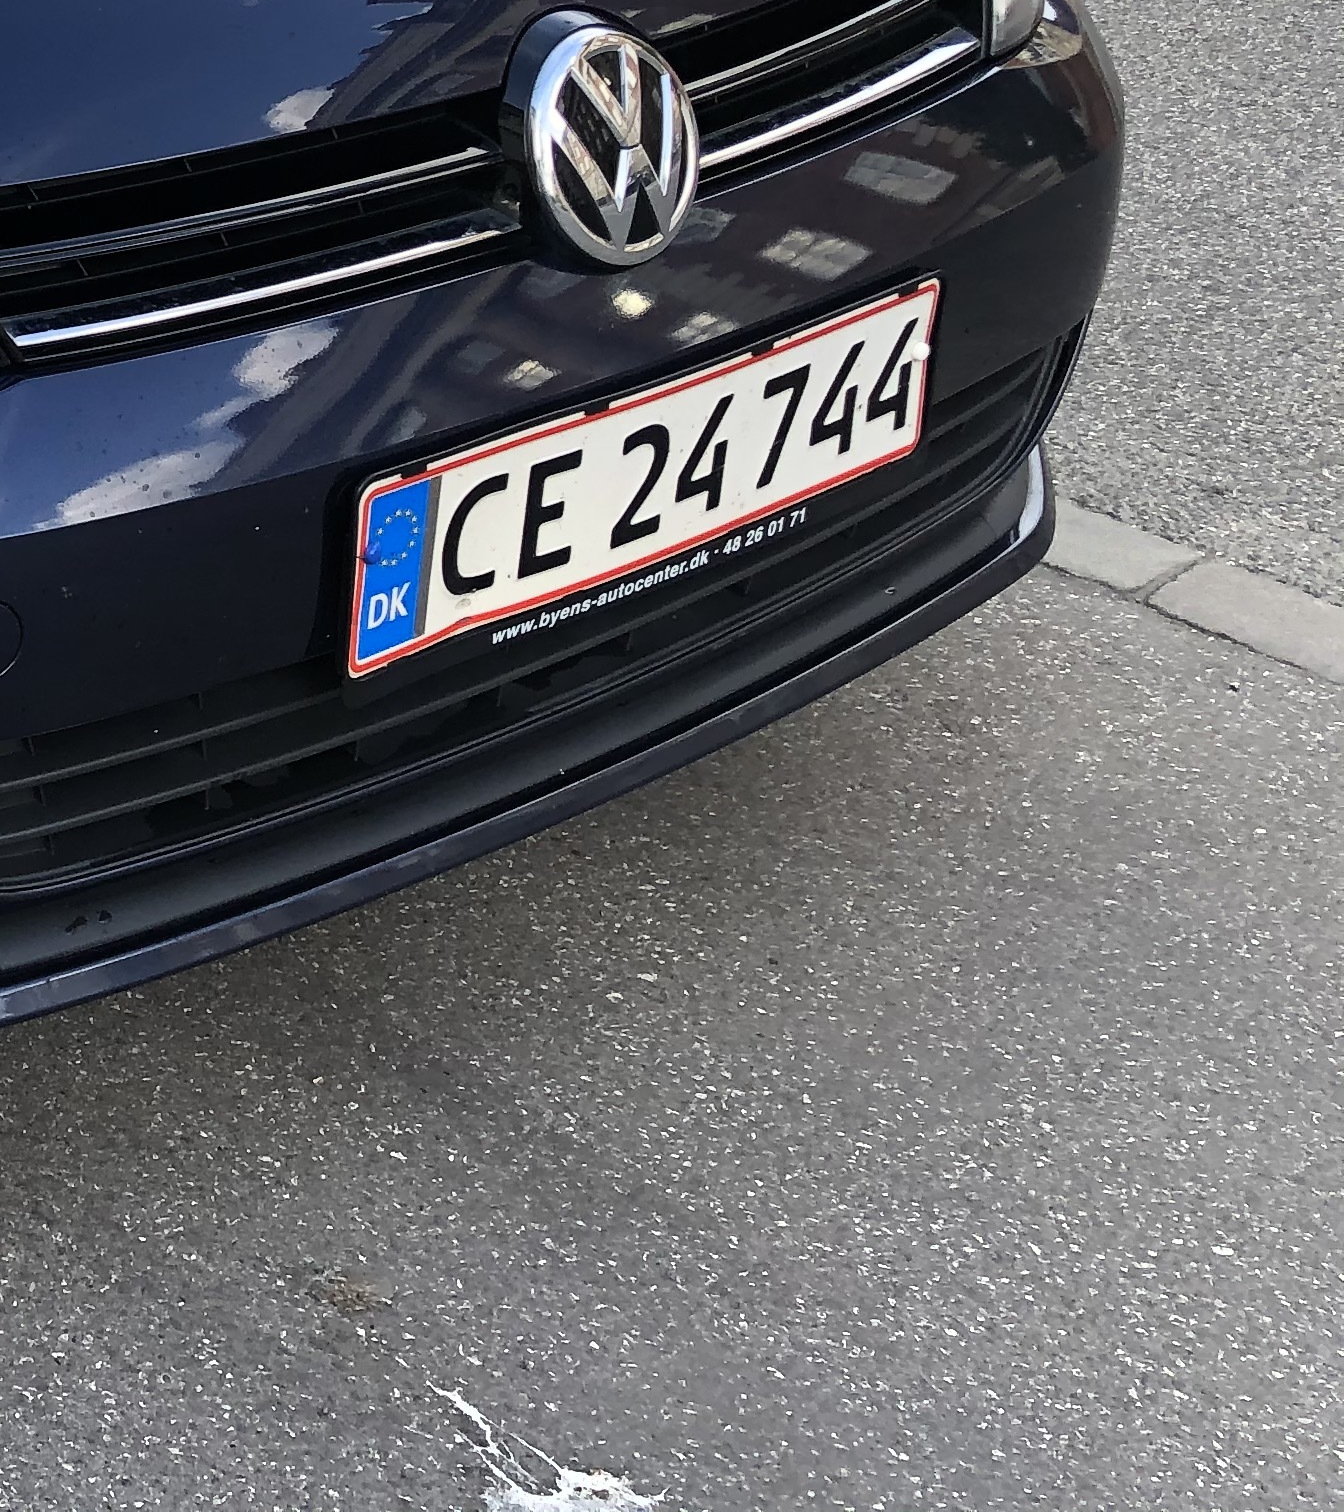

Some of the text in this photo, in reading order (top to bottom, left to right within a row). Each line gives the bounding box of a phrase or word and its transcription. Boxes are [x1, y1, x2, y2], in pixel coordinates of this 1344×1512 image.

[440, 316, 919, 597] CE 24 744
[366, 580, 409, 630] DK
[491, 549, 710, 645] www.byens-autocenter.dk
[722, 535, 742, 556] 48
[744, 525, 764, 547] 26
[767, 515, 786, 537] 01
[789, 506, 808, 528] 71
